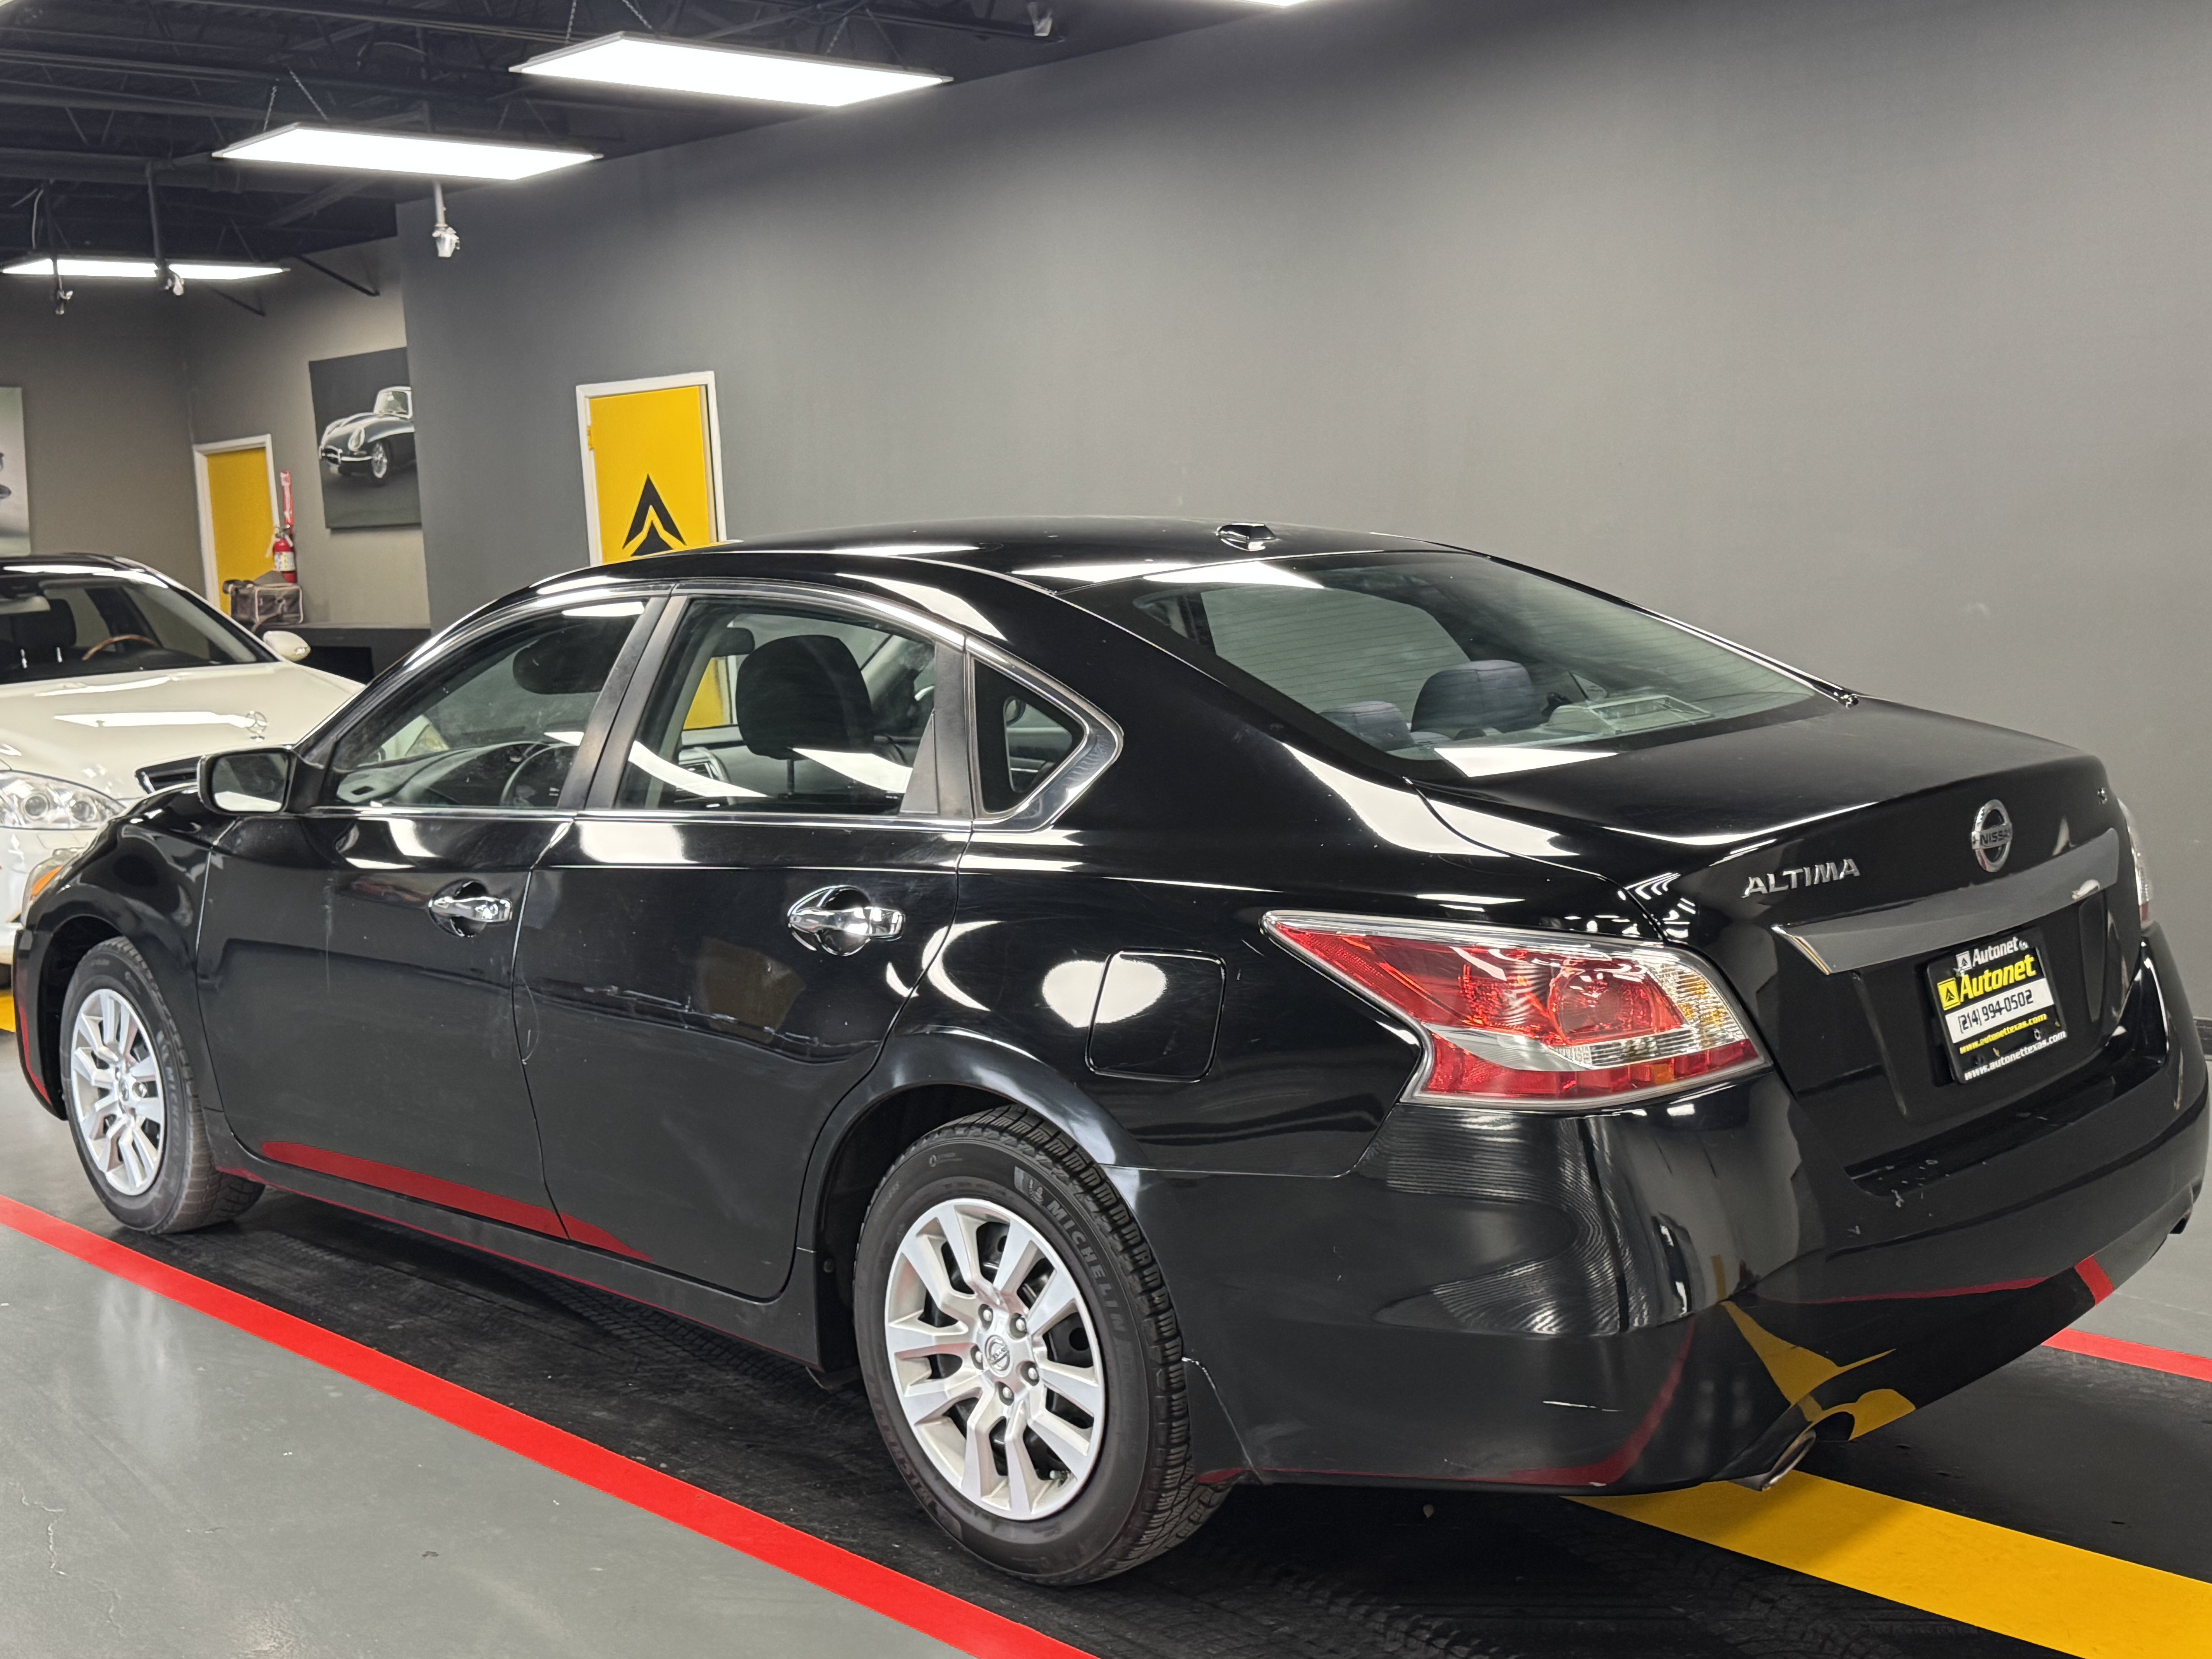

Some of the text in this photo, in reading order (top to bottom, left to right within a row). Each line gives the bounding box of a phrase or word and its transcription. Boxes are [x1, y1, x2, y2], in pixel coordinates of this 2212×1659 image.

[1741, 859, 1860, 898] ALTIMA
[1972, 936, 2019, 967] Autonet
[1960, 954, 2037, 1002] Autonet
[1958, 989, 2033, 1034] (214) 994-0502
[1959, 1013, 2048, 1054] www.autonettexas.com
[1965, 1030, 2067, 1080] www.autonettexas.com
[1047, 1200, 1125, 1331] MICHELIN
